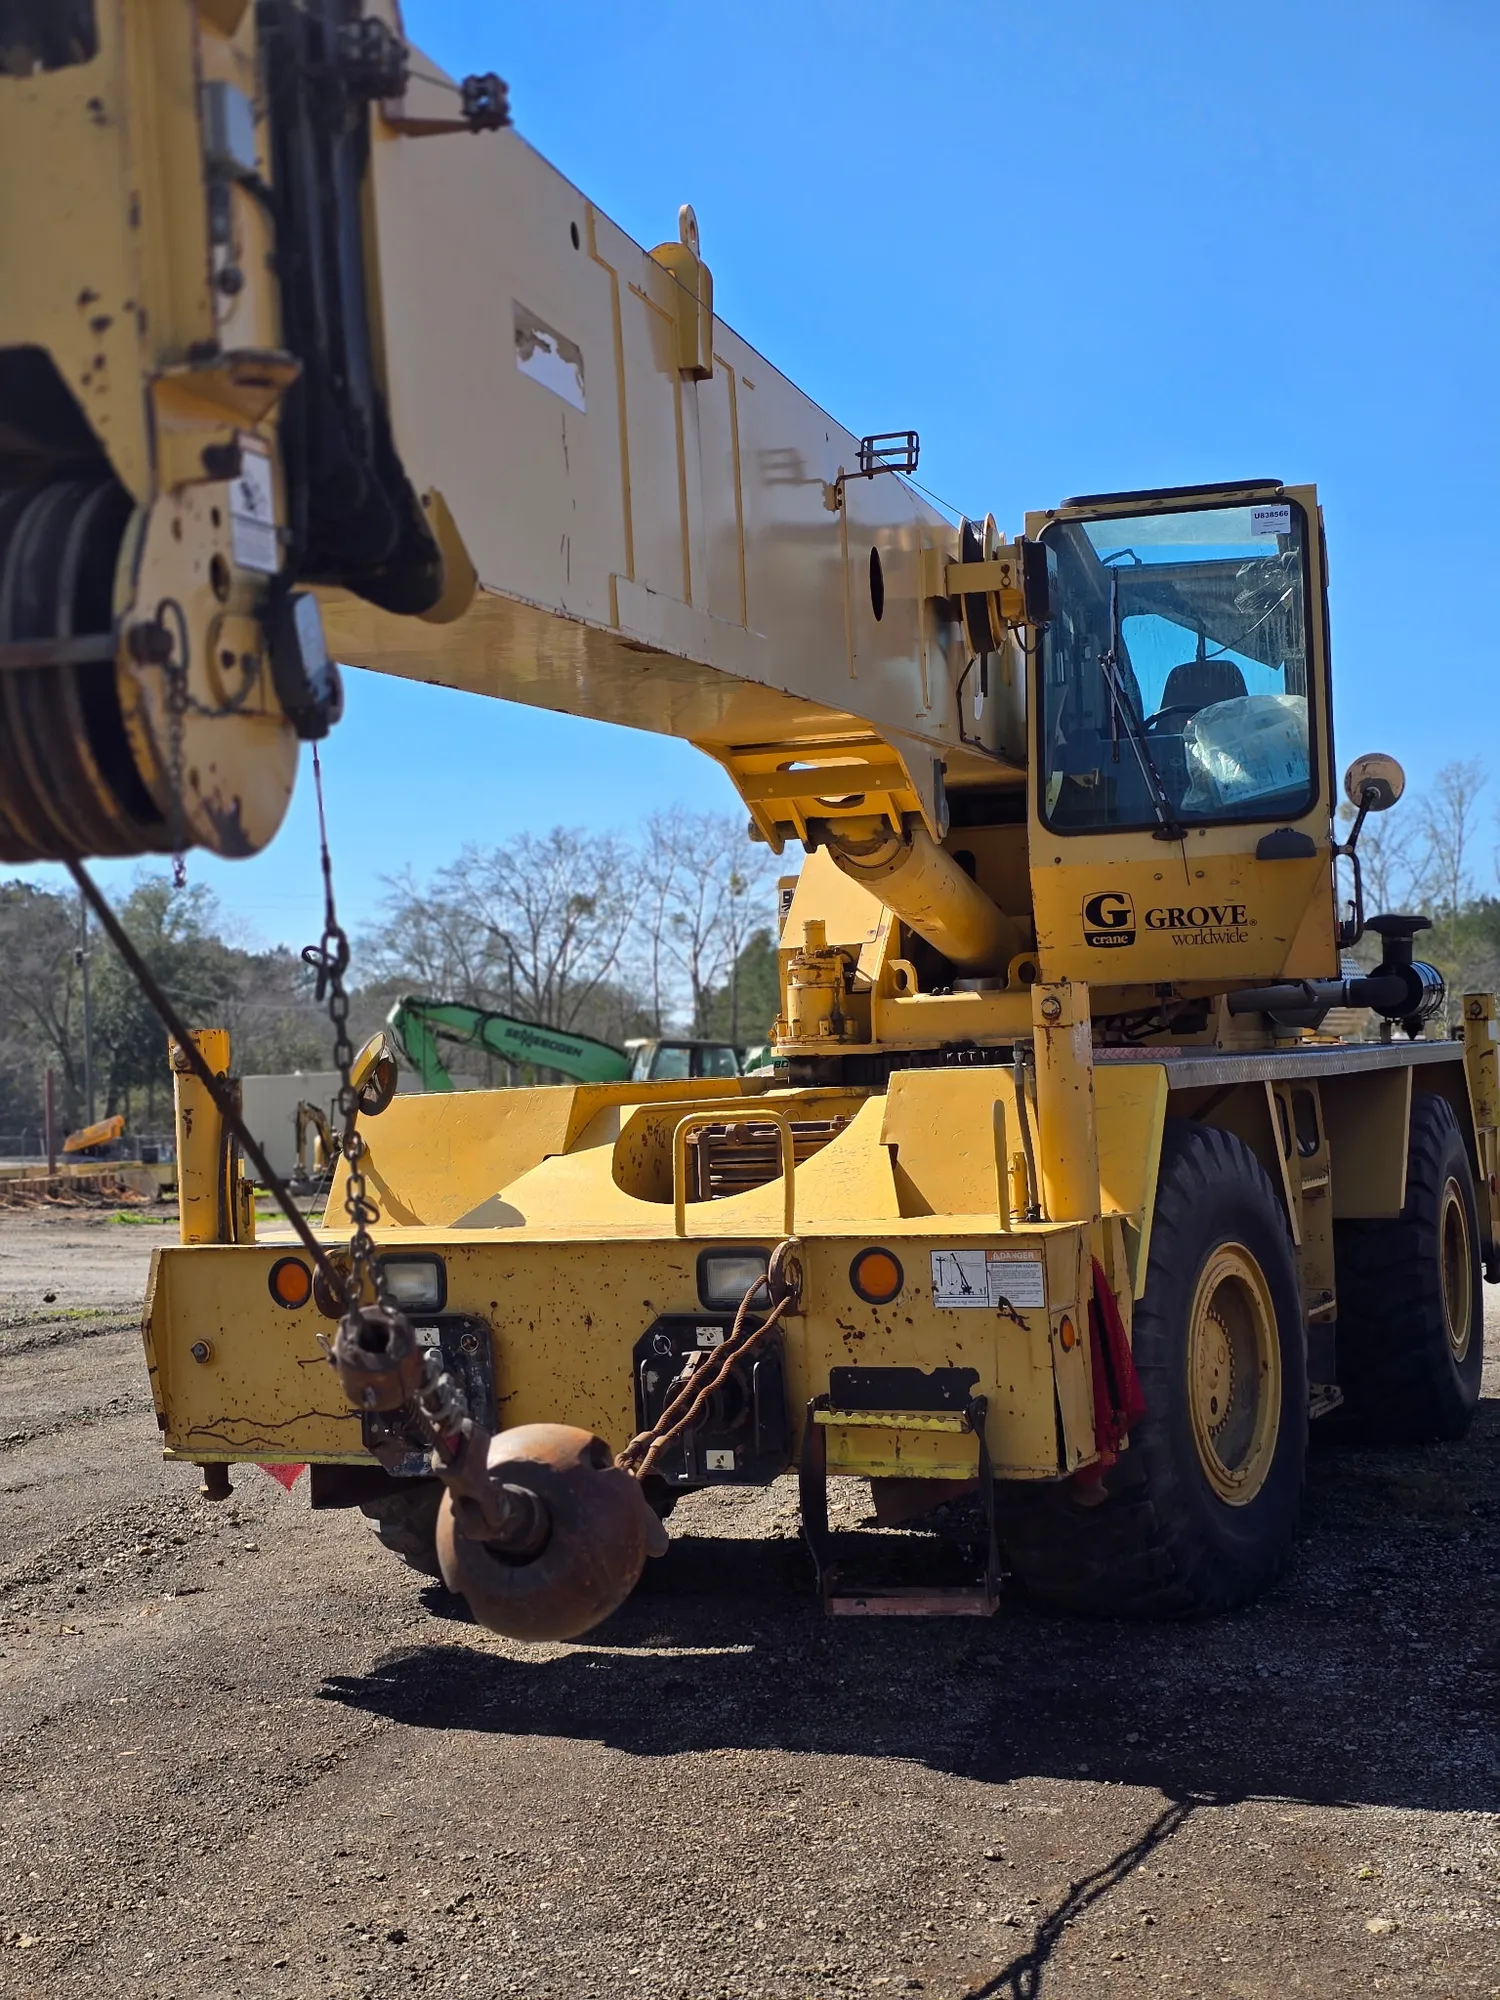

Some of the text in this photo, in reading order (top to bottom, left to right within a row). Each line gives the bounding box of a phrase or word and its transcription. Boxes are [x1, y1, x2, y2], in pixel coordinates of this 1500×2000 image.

[1254, 510, 1289, 519] U838566
[1085, 893, 1131, 928] G
[1144, 905, 1248, 929] GROVE
[1092, 934, 1129, 945] crane
[1172, 927, 1249, 946] worldwide
